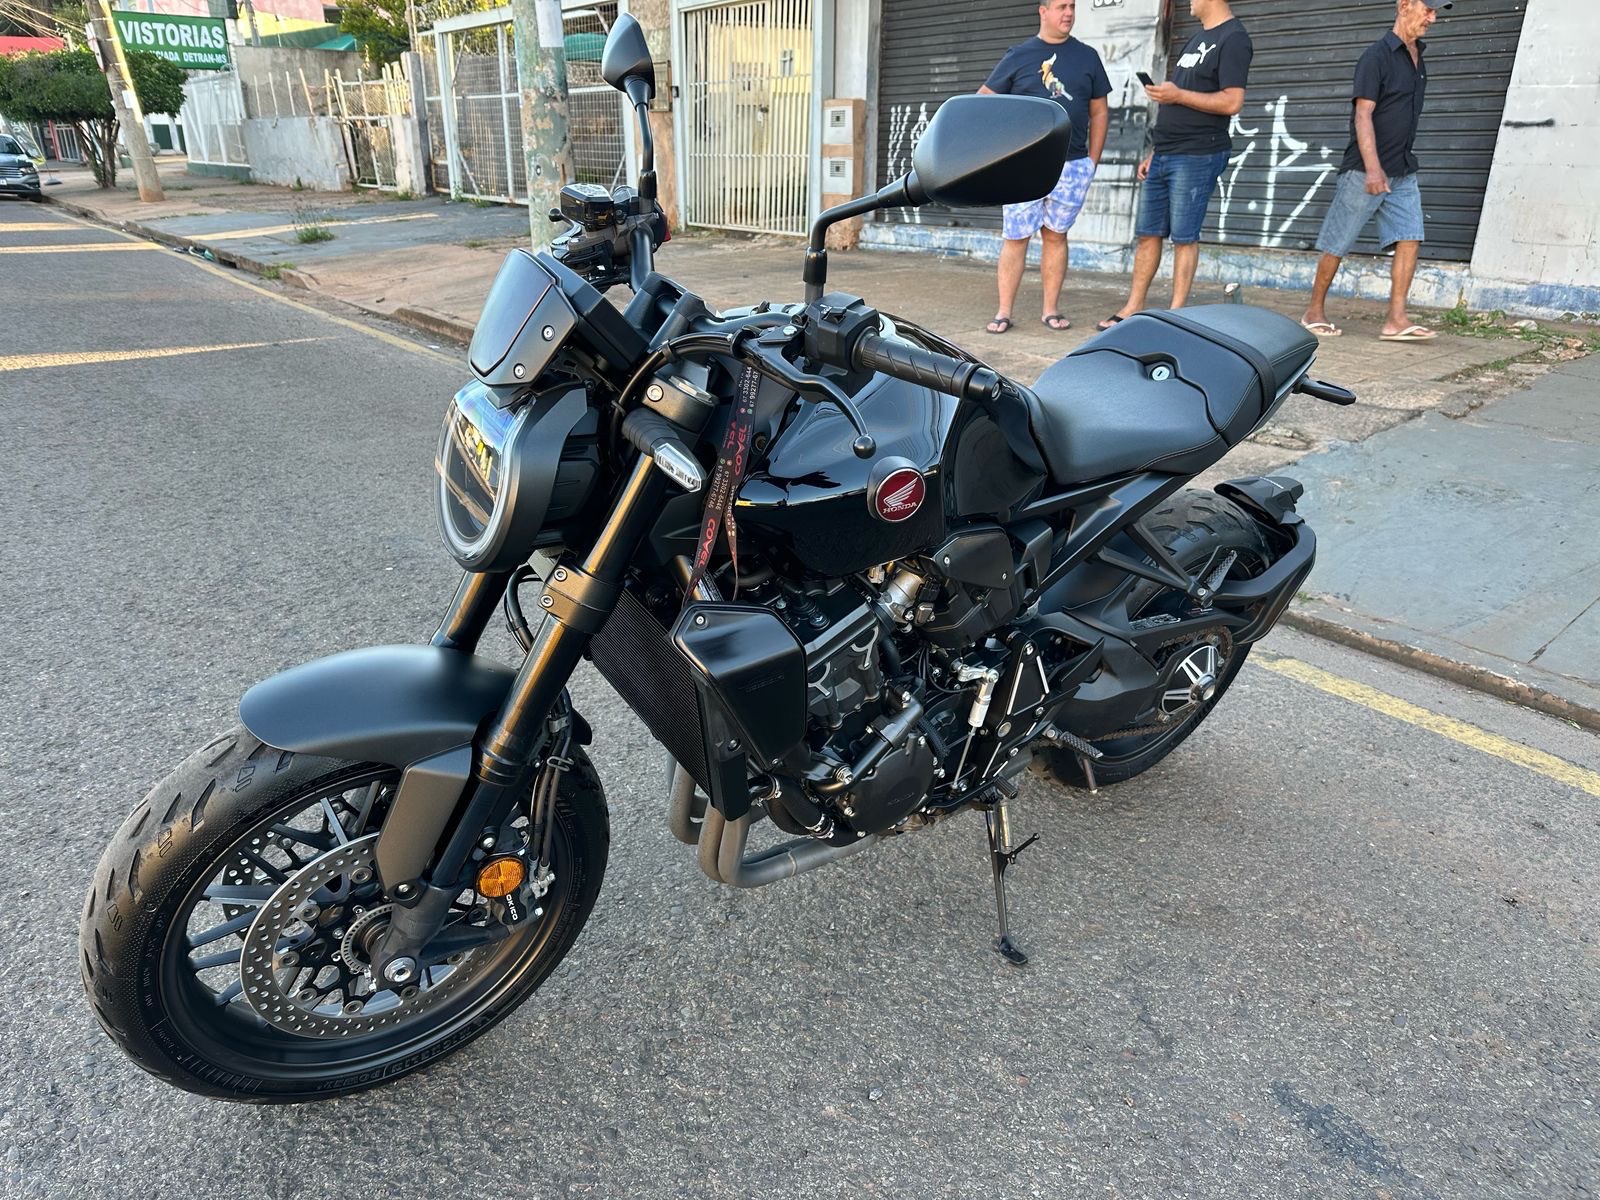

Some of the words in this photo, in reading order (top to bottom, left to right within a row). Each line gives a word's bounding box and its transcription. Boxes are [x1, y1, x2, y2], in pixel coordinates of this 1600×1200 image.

[118, 20, 225, 49] VISTORIAS
[183, 51, 227, 64] DETRAN-MS
[743, 366, 752, 395] 3302-644
[750, 371, 759, 400] 99277-67
[735, 425, 747, 475] COVEL
[883, 502, 917, 513] HONDA
[698, 518, 715, 567] COVEL
[506, 894, 518, 921] OKICO
